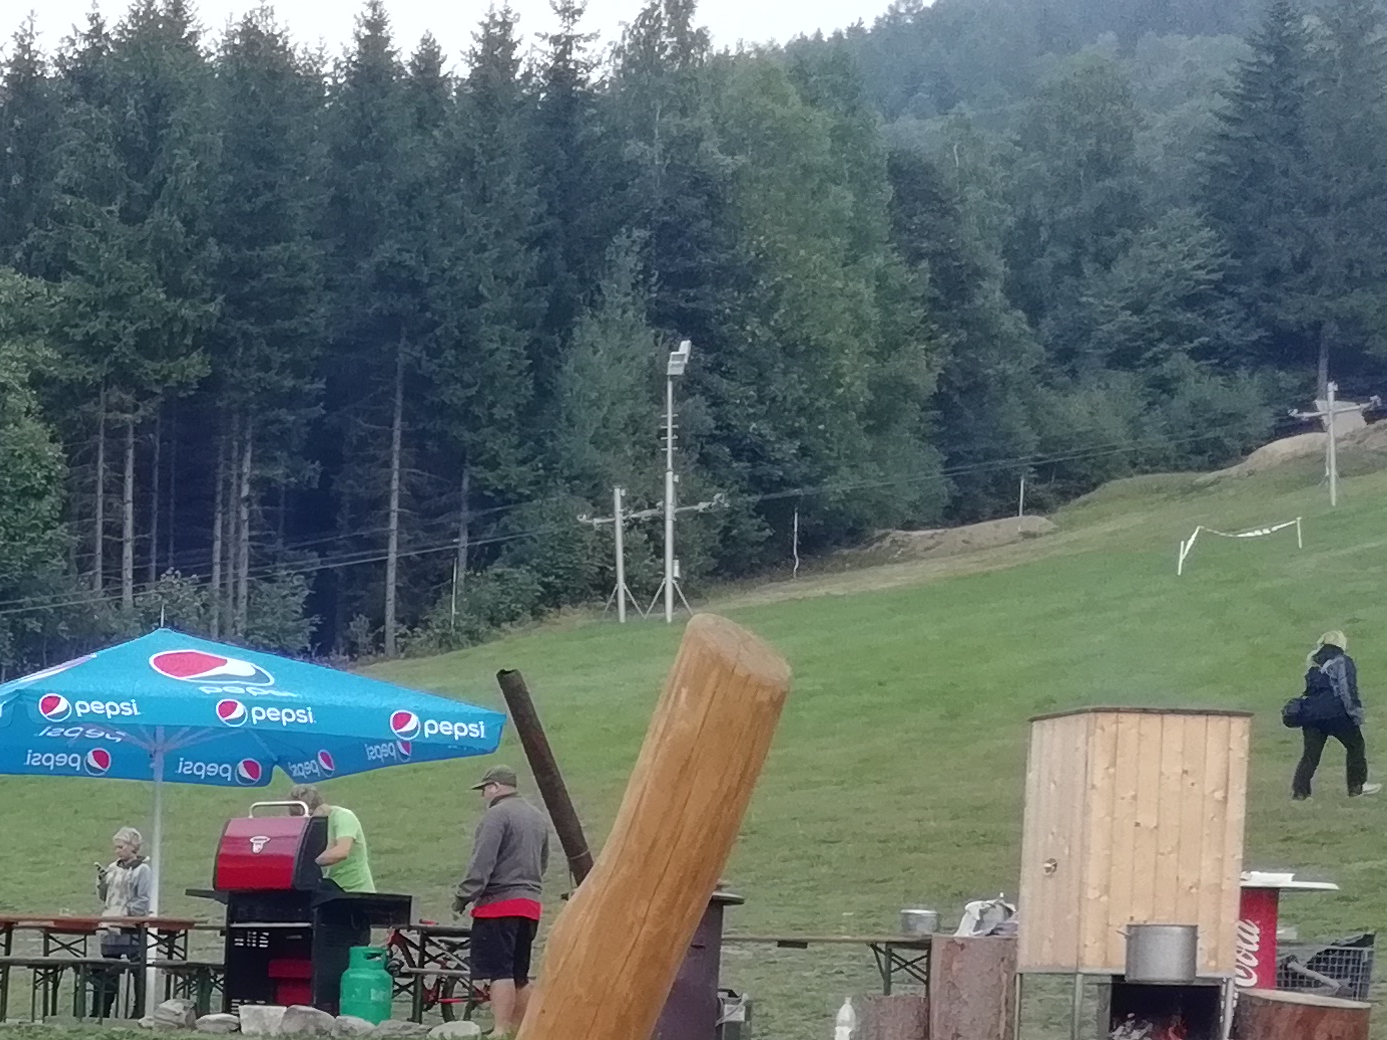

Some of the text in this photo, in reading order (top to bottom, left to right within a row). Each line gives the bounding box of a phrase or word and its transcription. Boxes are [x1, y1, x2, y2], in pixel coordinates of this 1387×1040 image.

[74, 698, 139, 718] pepsi
[251, 706, 314, 726] pepsi
[424, 719, 485, 740] pepsi
